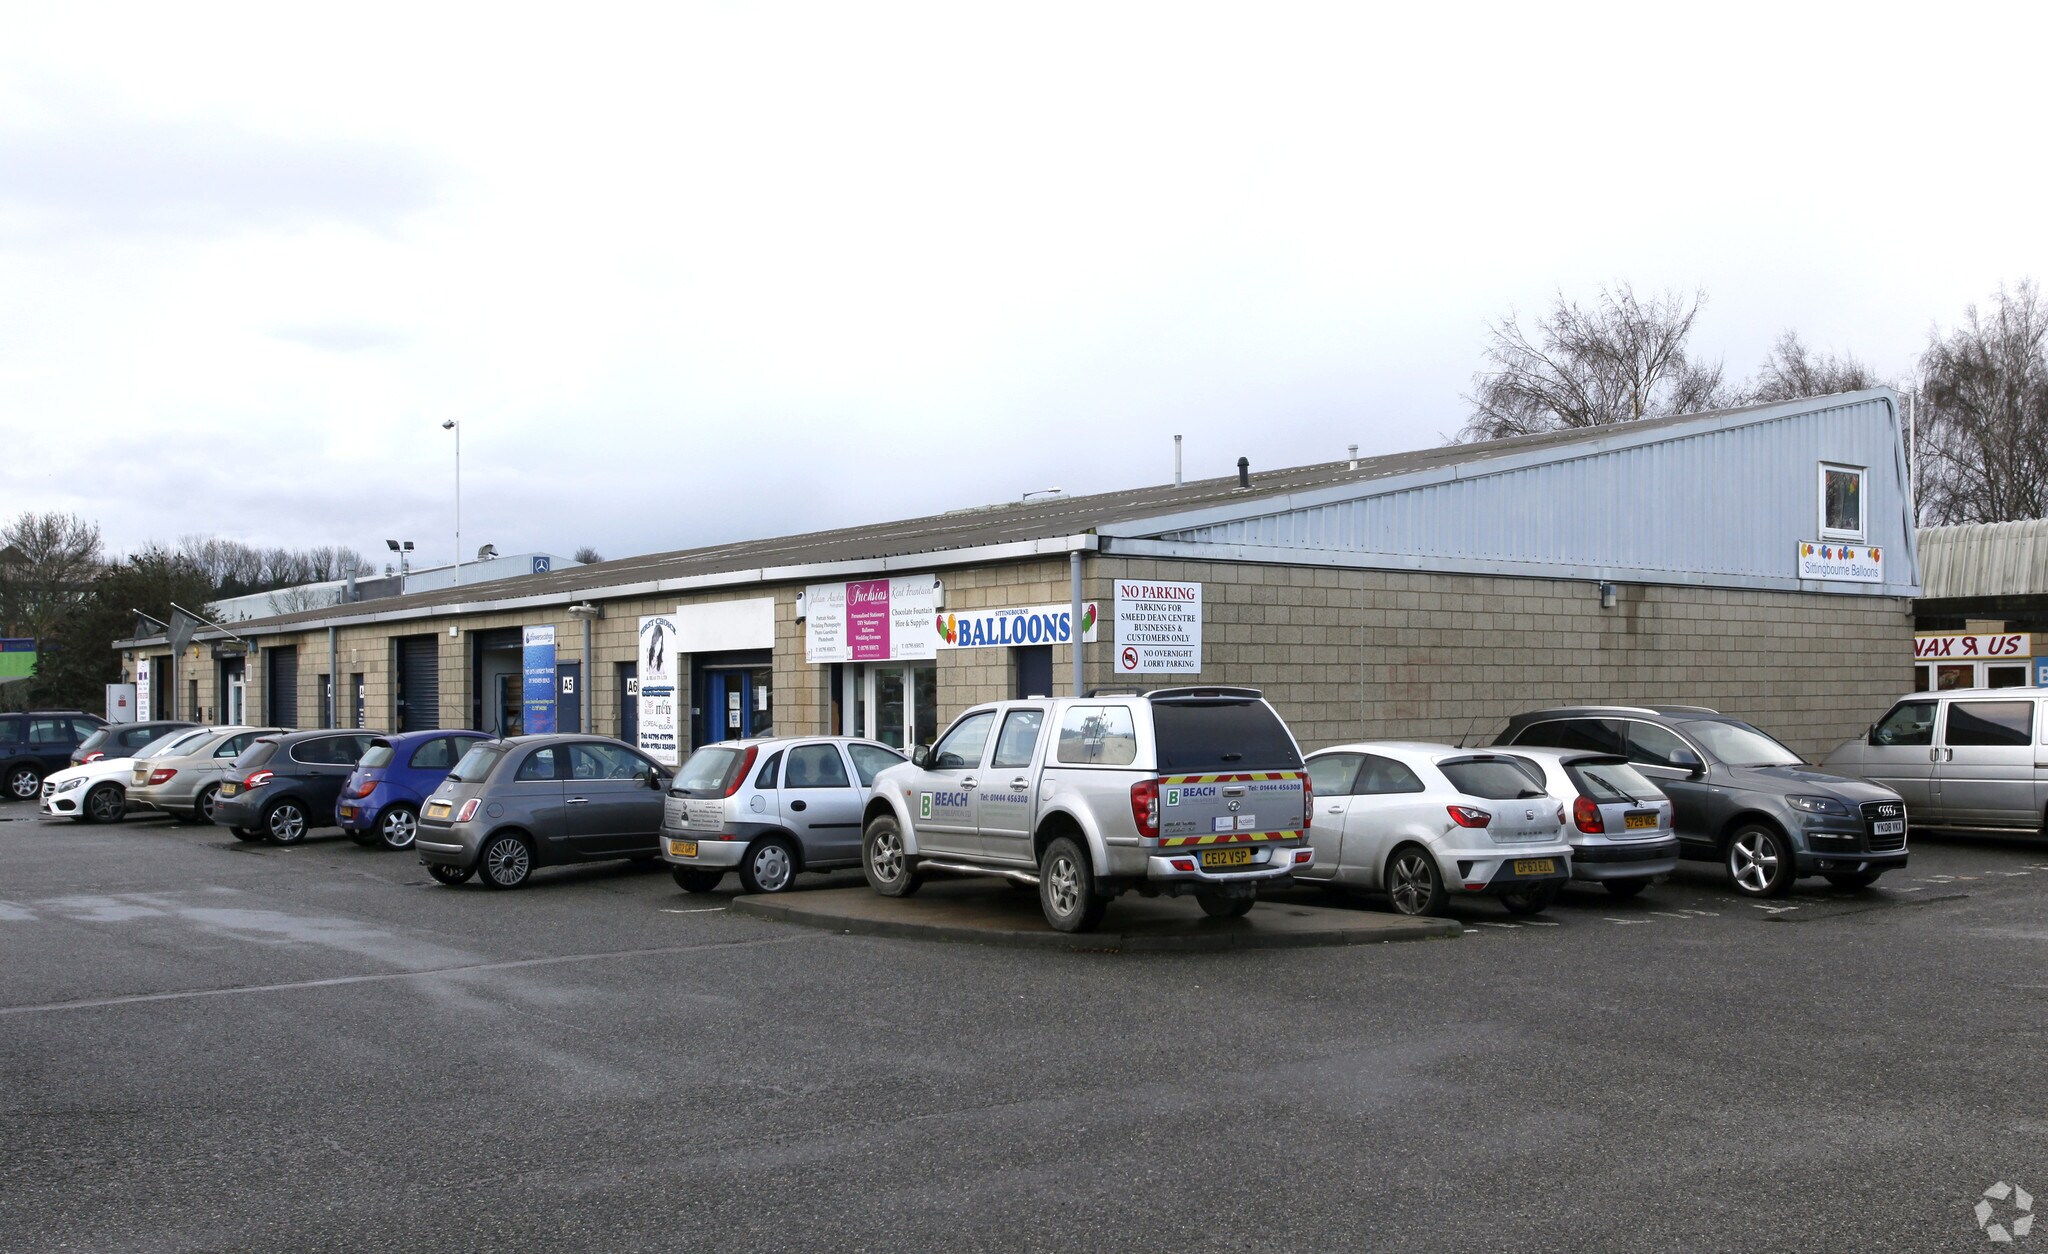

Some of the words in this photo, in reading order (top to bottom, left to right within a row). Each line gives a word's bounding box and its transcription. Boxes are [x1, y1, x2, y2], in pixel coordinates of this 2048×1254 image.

[1805, 562, 1850, 577] Sittingbourne
[1852, 564, 1879, 578] Balloons
[847, 584, 888, 606] Fuchsias
[1121, 585, 1139, 598] NO
[1142, 586, 1195, 600] PARKING
[892, 608, 913, 616] Chocolate
[913, 607, 932, 615] Fountain
[995, 609, 1029, 617] SITTINGBOURNE
[1136, 604, 1167, 612] PARKING
[1168, 604, 1182, 612] FOR
[1121, 613, 1146, 621] SMEED
[1168, 614, 1196, 622] CENTRE
[895, 620, 905, 628] Hire
[911, 619, 929, 628] Supplies
[1134, 624, 1176, 632] BUSINESSES
[958, 612, 1070, 647] BALLOONS
[1127, 634, 1170, 642] CUSTOMERS
[1988, 635, 2022, 655] US
[1144, 660, 1165, 668] LORRY
[564, 679, 573, 691] A5
[628, 680, 638, 693] A6
[1183, 787, 1216, 797] BEACH
[935, 792, 968, 807] BEACH
[980, 793, 989, 801] Tel:
[990, 794, 1006, 802] 01444
[1007, 795, 1028, 804] 456308
[1169, 791, 1179, 805] B
[922, 796, 931, 816] B
[1627, 817, 1643, 828] S729
[1877, 823, 1891, 833] YK08
[1205, 853, 1227, 865] CE12
[1229, 851, 1247, 864] VSP
[1518, 861, 1537, 873] GF63
[1538, 861, 1552, 872] EZL
